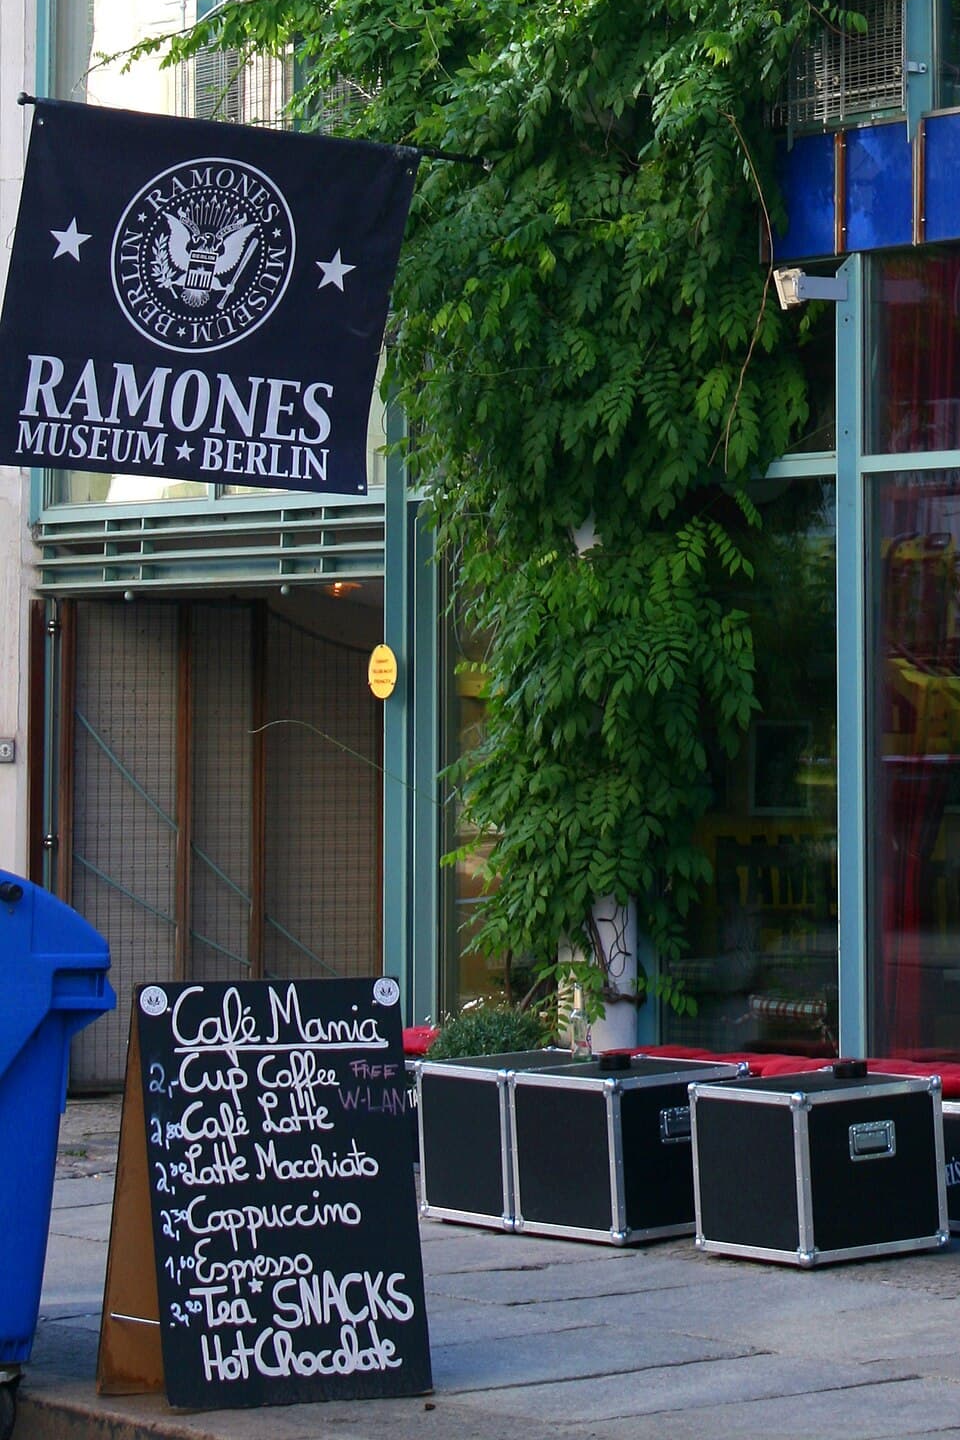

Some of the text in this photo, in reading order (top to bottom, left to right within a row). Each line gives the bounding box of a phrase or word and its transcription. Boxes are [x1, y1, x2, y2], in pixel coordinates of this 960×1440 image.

[144, 166, 280, 223] RAMONES
[121, 229, 177, 337] BERLIN
[191, 245, 287, 343] MUSEUM
[19, 354, 334, 445] RAMONES
[15, 420, 329, 481] MUSEUM BERLIN
[172, 986, 261, 1067] Café
[266, 983, 386, 1043] Mania
[179, 1051, 248, 1110] Cup
[257, 1050, 340, 1109] Coffee
[349, 1060, 398, 1080] FREE
[181, 1101, 250, 1154] Café
[257, 1091, 334, 1134] Latte
[338, 1087, 406, 1115] W-LAN
[182, 1141, 250, 1186] Latte
[254, 1138, 379, 1181] Macchiato
[187, 1190, 362, 1252] Cappuccino
[194, 1238, 314, 1296] Espresso
[189, 1285, 257, 1328] Tea
[272, 1270, 414, 1329] SNACKS
[201, 1320, 403, 1382] Hot Chocolate
